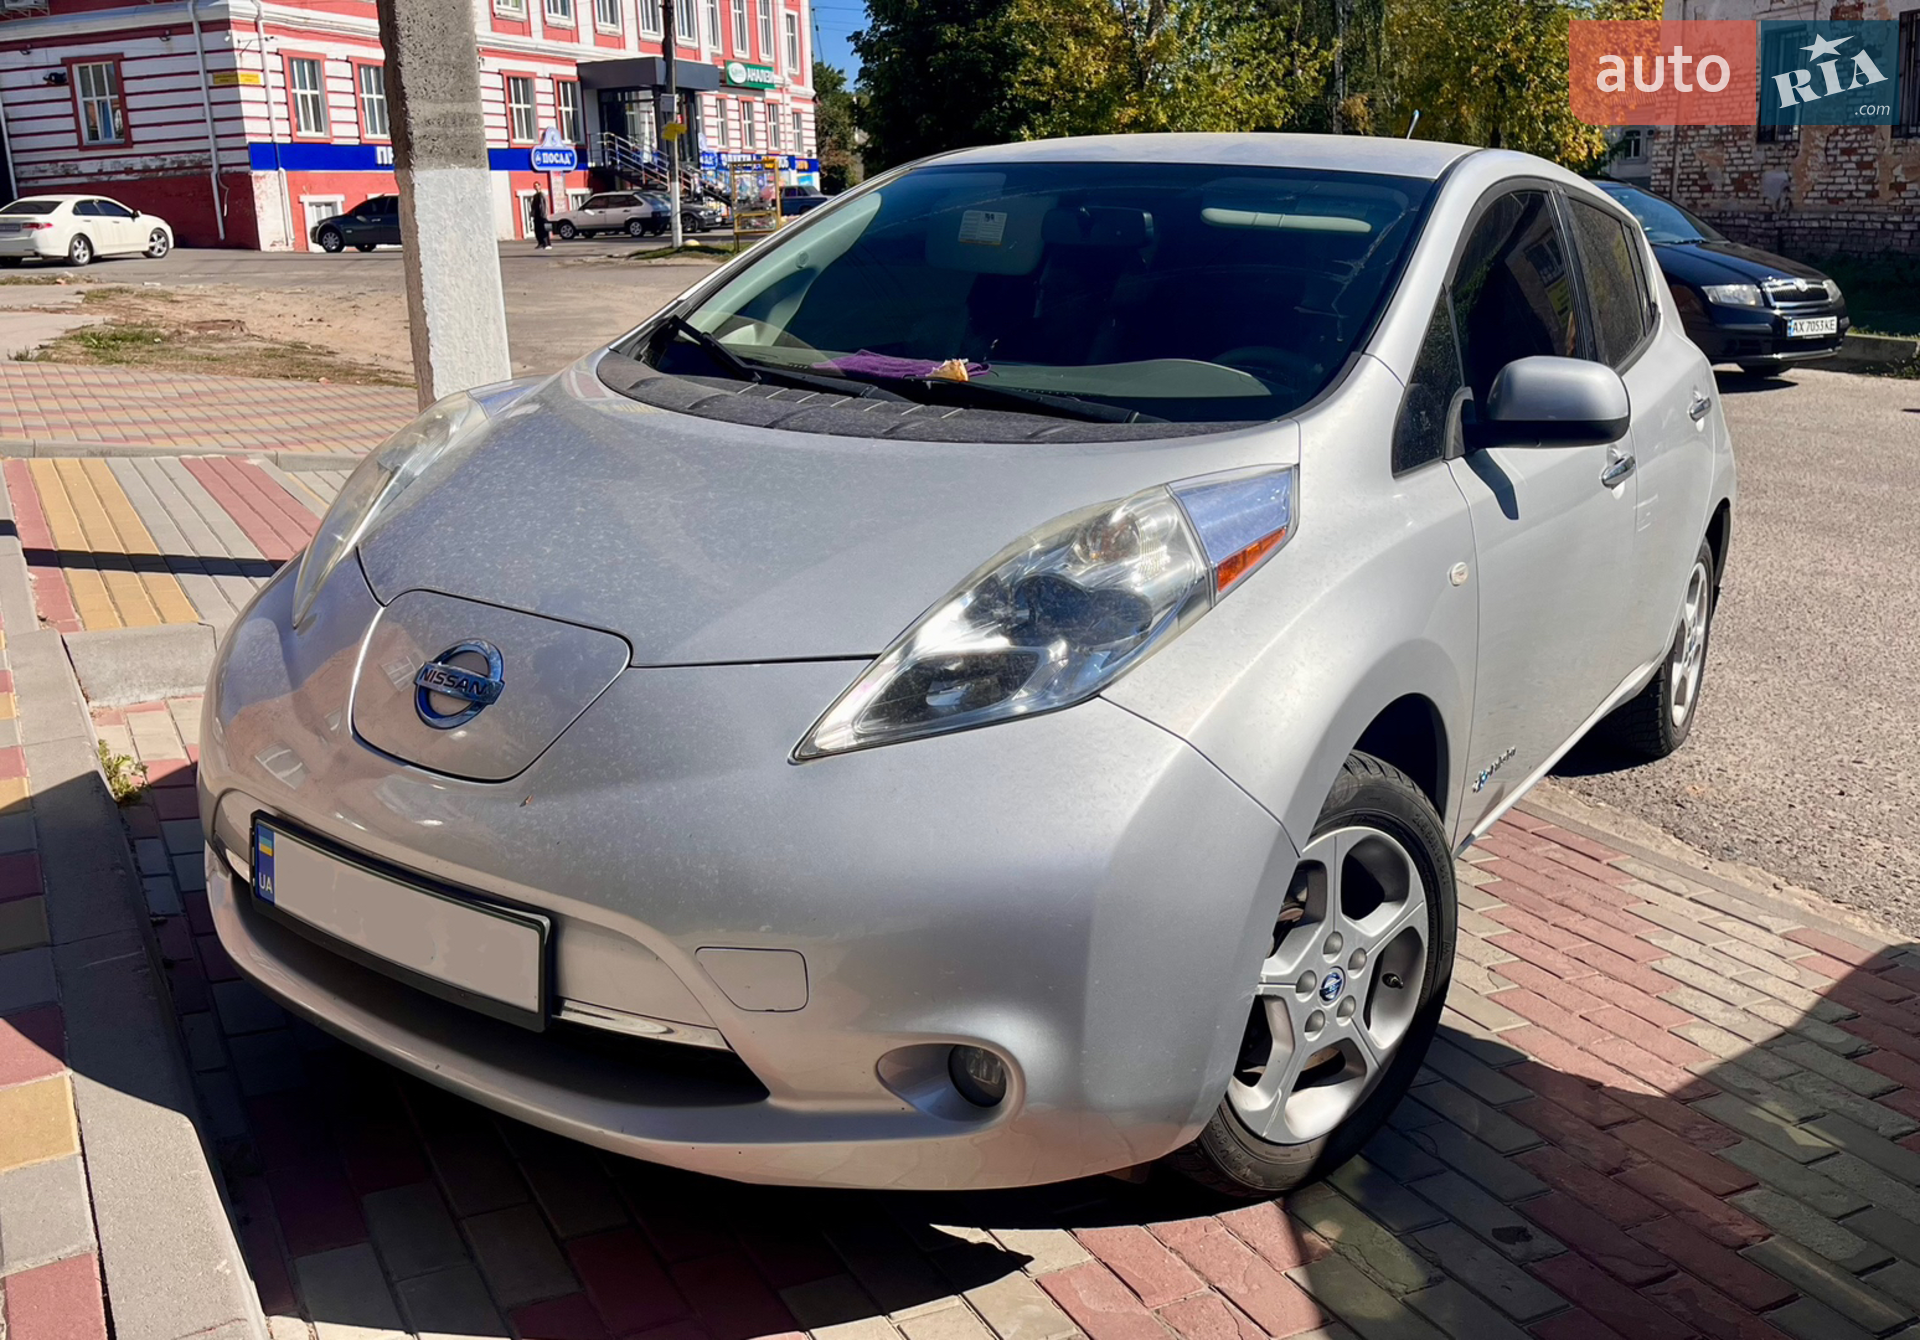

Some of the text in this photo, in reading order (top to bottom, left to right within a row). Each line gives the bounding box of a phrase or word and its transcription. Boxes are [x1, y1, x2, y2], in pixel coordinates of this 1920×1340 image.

[541, 151, 572, 166] ПОСАД
[1793, 321, 1805, 334] AX
[419, 667, 488, 696] NISSAN
[258, 870, 274, 895] UA
